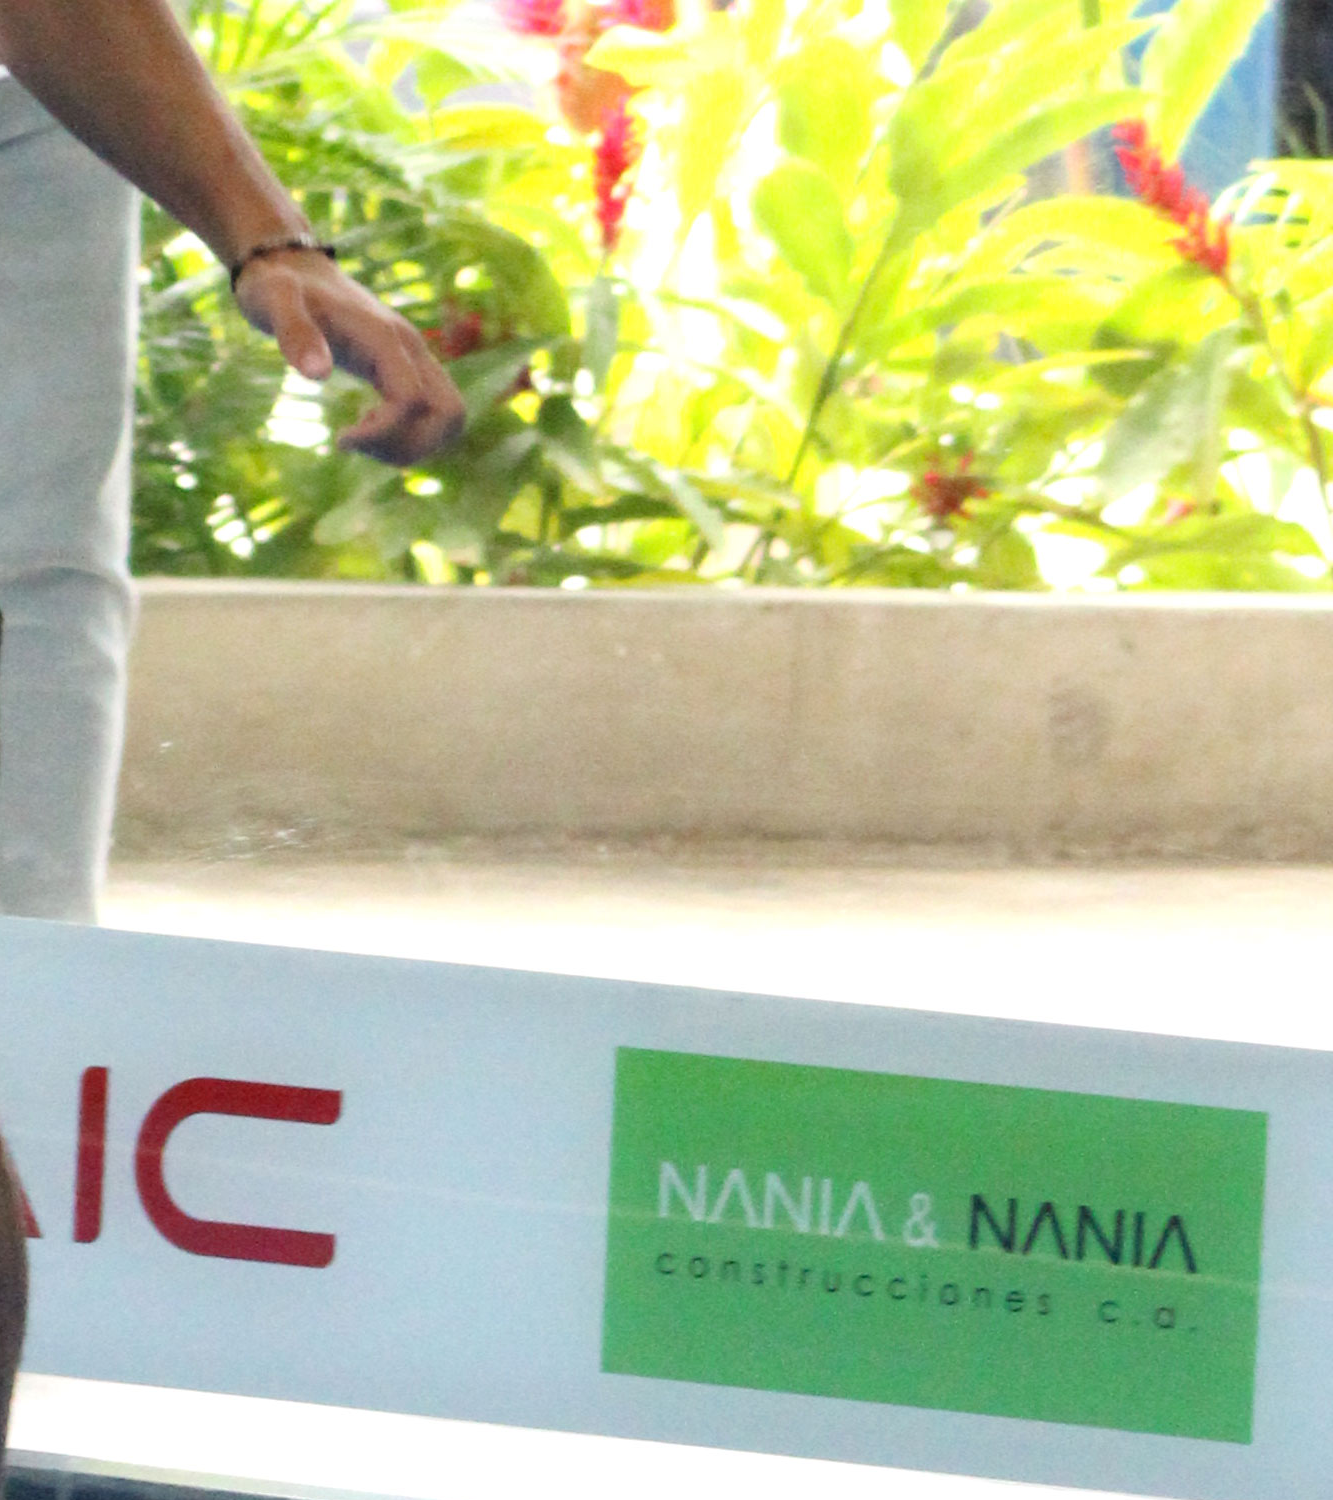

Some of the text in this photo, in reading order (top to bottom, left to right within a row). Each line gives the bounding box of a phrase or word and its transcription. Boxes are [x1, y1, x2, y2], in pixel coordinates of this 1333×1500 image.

[656, 1160, 1199, 1275] NANIA & NANIA
[653, 1250, 1055, 1318] construcciones
